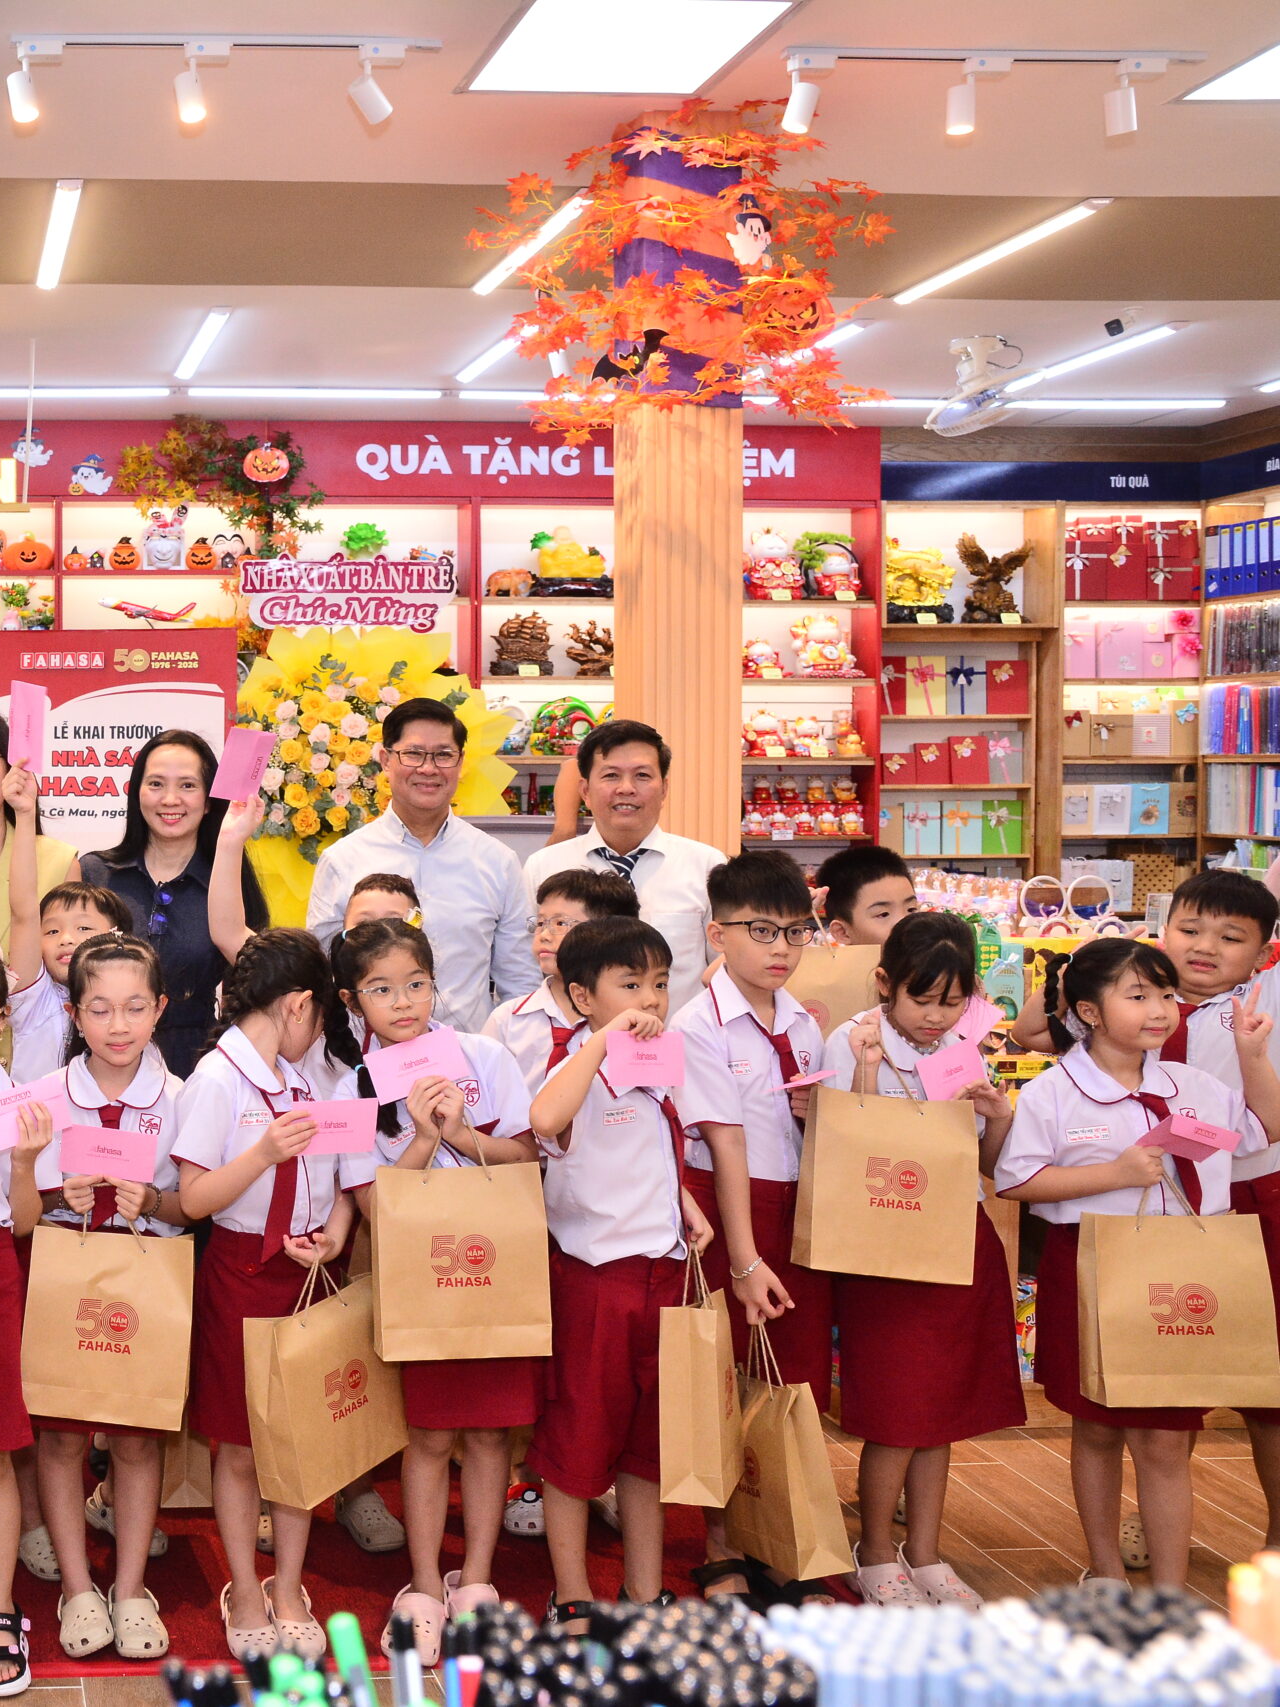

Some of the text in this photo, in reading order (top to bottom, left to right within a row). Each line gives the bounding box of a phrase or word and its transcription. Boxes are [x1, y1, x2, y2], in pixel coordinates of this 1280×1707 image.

[355, 434, 452, 480] QUÀ
[463, 437, 581, 484] TẶNG
[743, 441, 796, 486] ỆM
[1109, 472, 1150, 489] TÚI QUÀ
[297, 556, 354, 591] XUẤT
[359, 557, 403, 590] BẢN
[407, 557, 452, 590] TRẺ
[263, 598, 436, 629] Chúc Mừng
[21, 652, 105, 669] FAHASA
[113, 648, 198, 673] 50 FAHASA
[151, 661, 199, 669] 1976 2026
[53, 720, 68, 740] LỄ
[73, 725, 105, 739] KHAI
[51, 746, 140, 767] NHÀ SÁ
[37, 776, 120, 797] HASA
[49, 807, 65, 817] Cà
[68, 808, 98, 818] Mau,
[102, 807, 127, 819] ngà
[403, 1056, 429, 1070] fahasa
[636, 1051, 658, 1061] fahasa
[96, 1145, 122, 1157] fahasa
[865, 1156, 928, 1200] 50
[869, 1196, 922, 1212] FAHASA
[430, 1234, 497, 1277] 50
[437, 1275, 493, 1288] FAHASA
[1148, 1283, 1218, 1325] 50
[75, 1298, 140, 1342] 50
[1157, 1324, 1215, 1336] FAHASA
[78, 1339, 131, 1355] FAHASA
[324, 1358, 369, 1411] 50
[332, 1394, 369, 1423] FAHASA
[736, 1481, 761, 1500] AHASA
